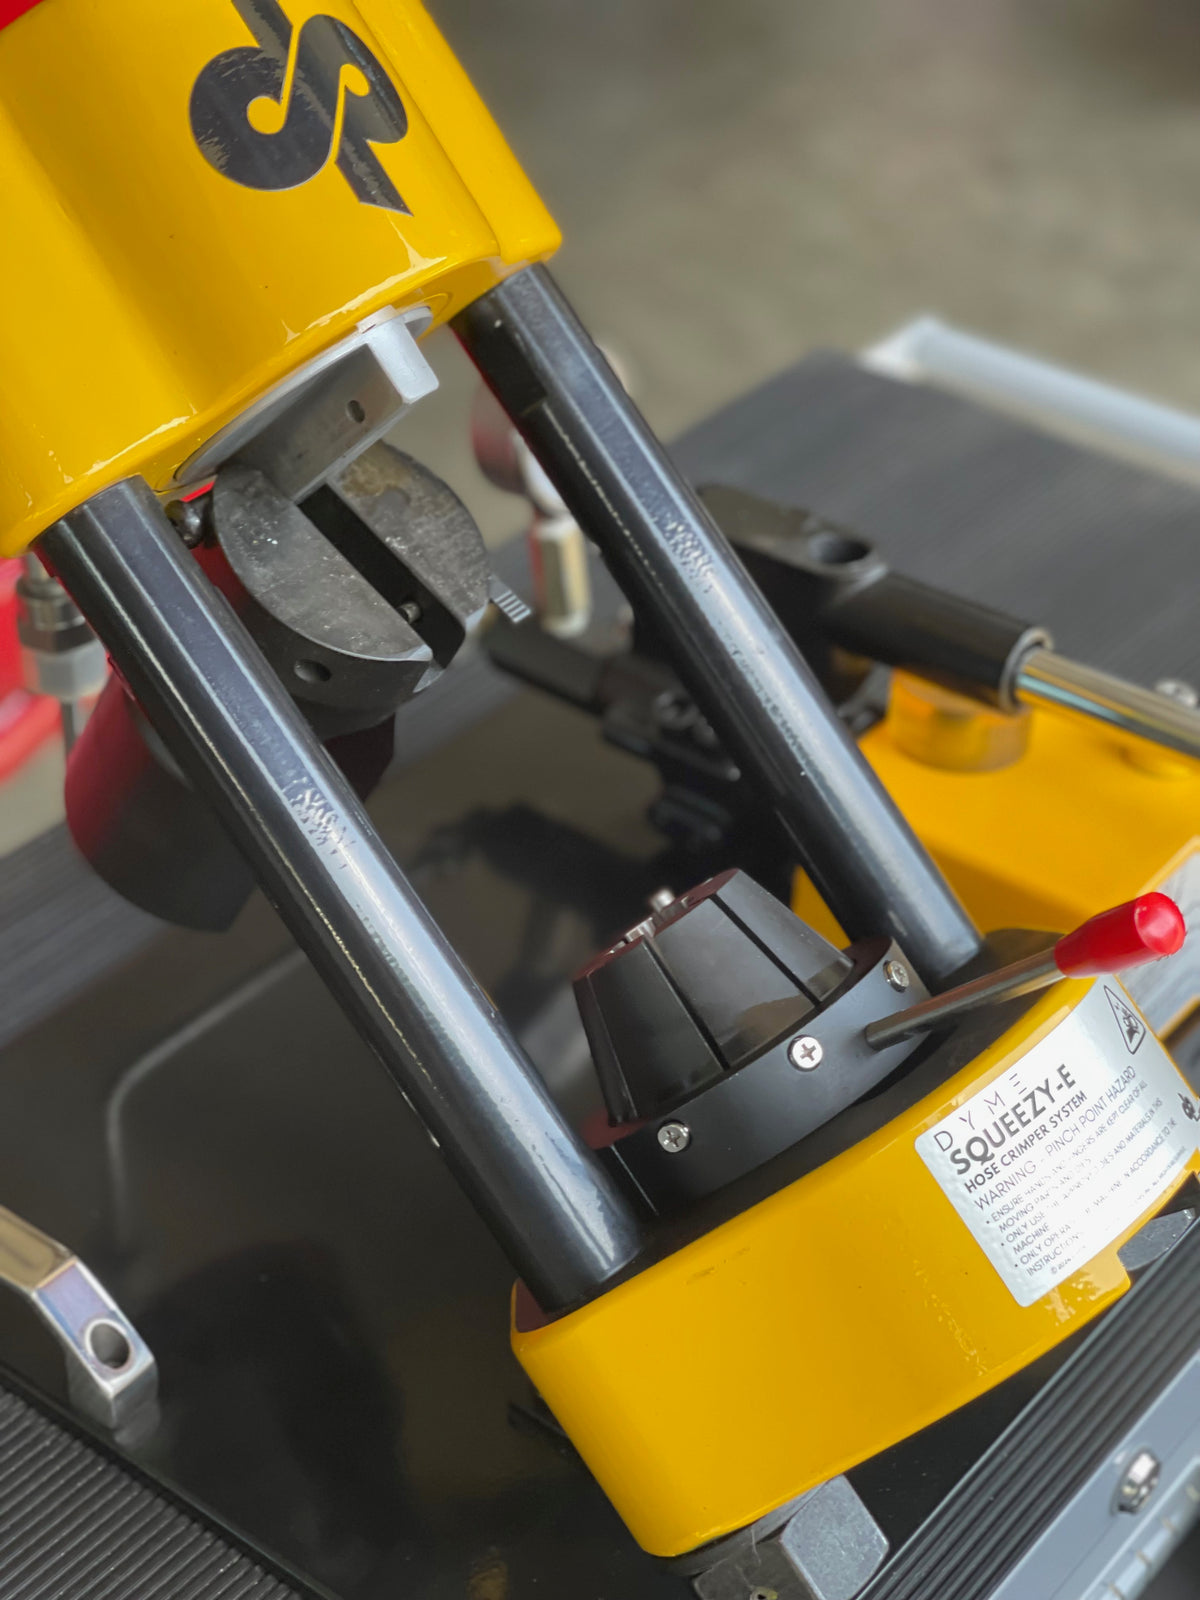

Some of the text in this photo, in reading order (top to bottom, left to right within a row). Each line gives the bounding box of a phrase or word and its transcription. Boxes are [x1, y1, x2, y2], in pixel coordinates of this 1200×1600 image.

[951, 1064, 1076, 1175] SQUEEZY-E
[964, 1162, 1001, 1194] HOSE
[1001, 1125, 1051, 1167] CRIMPER
[1049, 1091, 1088, 1129] SYSTEM
[974, 1161, 1037, 1211] WARNING
[1045, 1123, 1081, 1157] PINCH
[1079, 1096, 1108, 1129] POINT
[1105, 1066, 1136, 1103] HAZARD
[991, 1194, 1025, 1223] ENSURE
[999, 1203, 1035, 1234] MOVING
[1006, 1222, 1028, 1244] ONLY
[1020, 1244, 1043, 1266] ONLY
